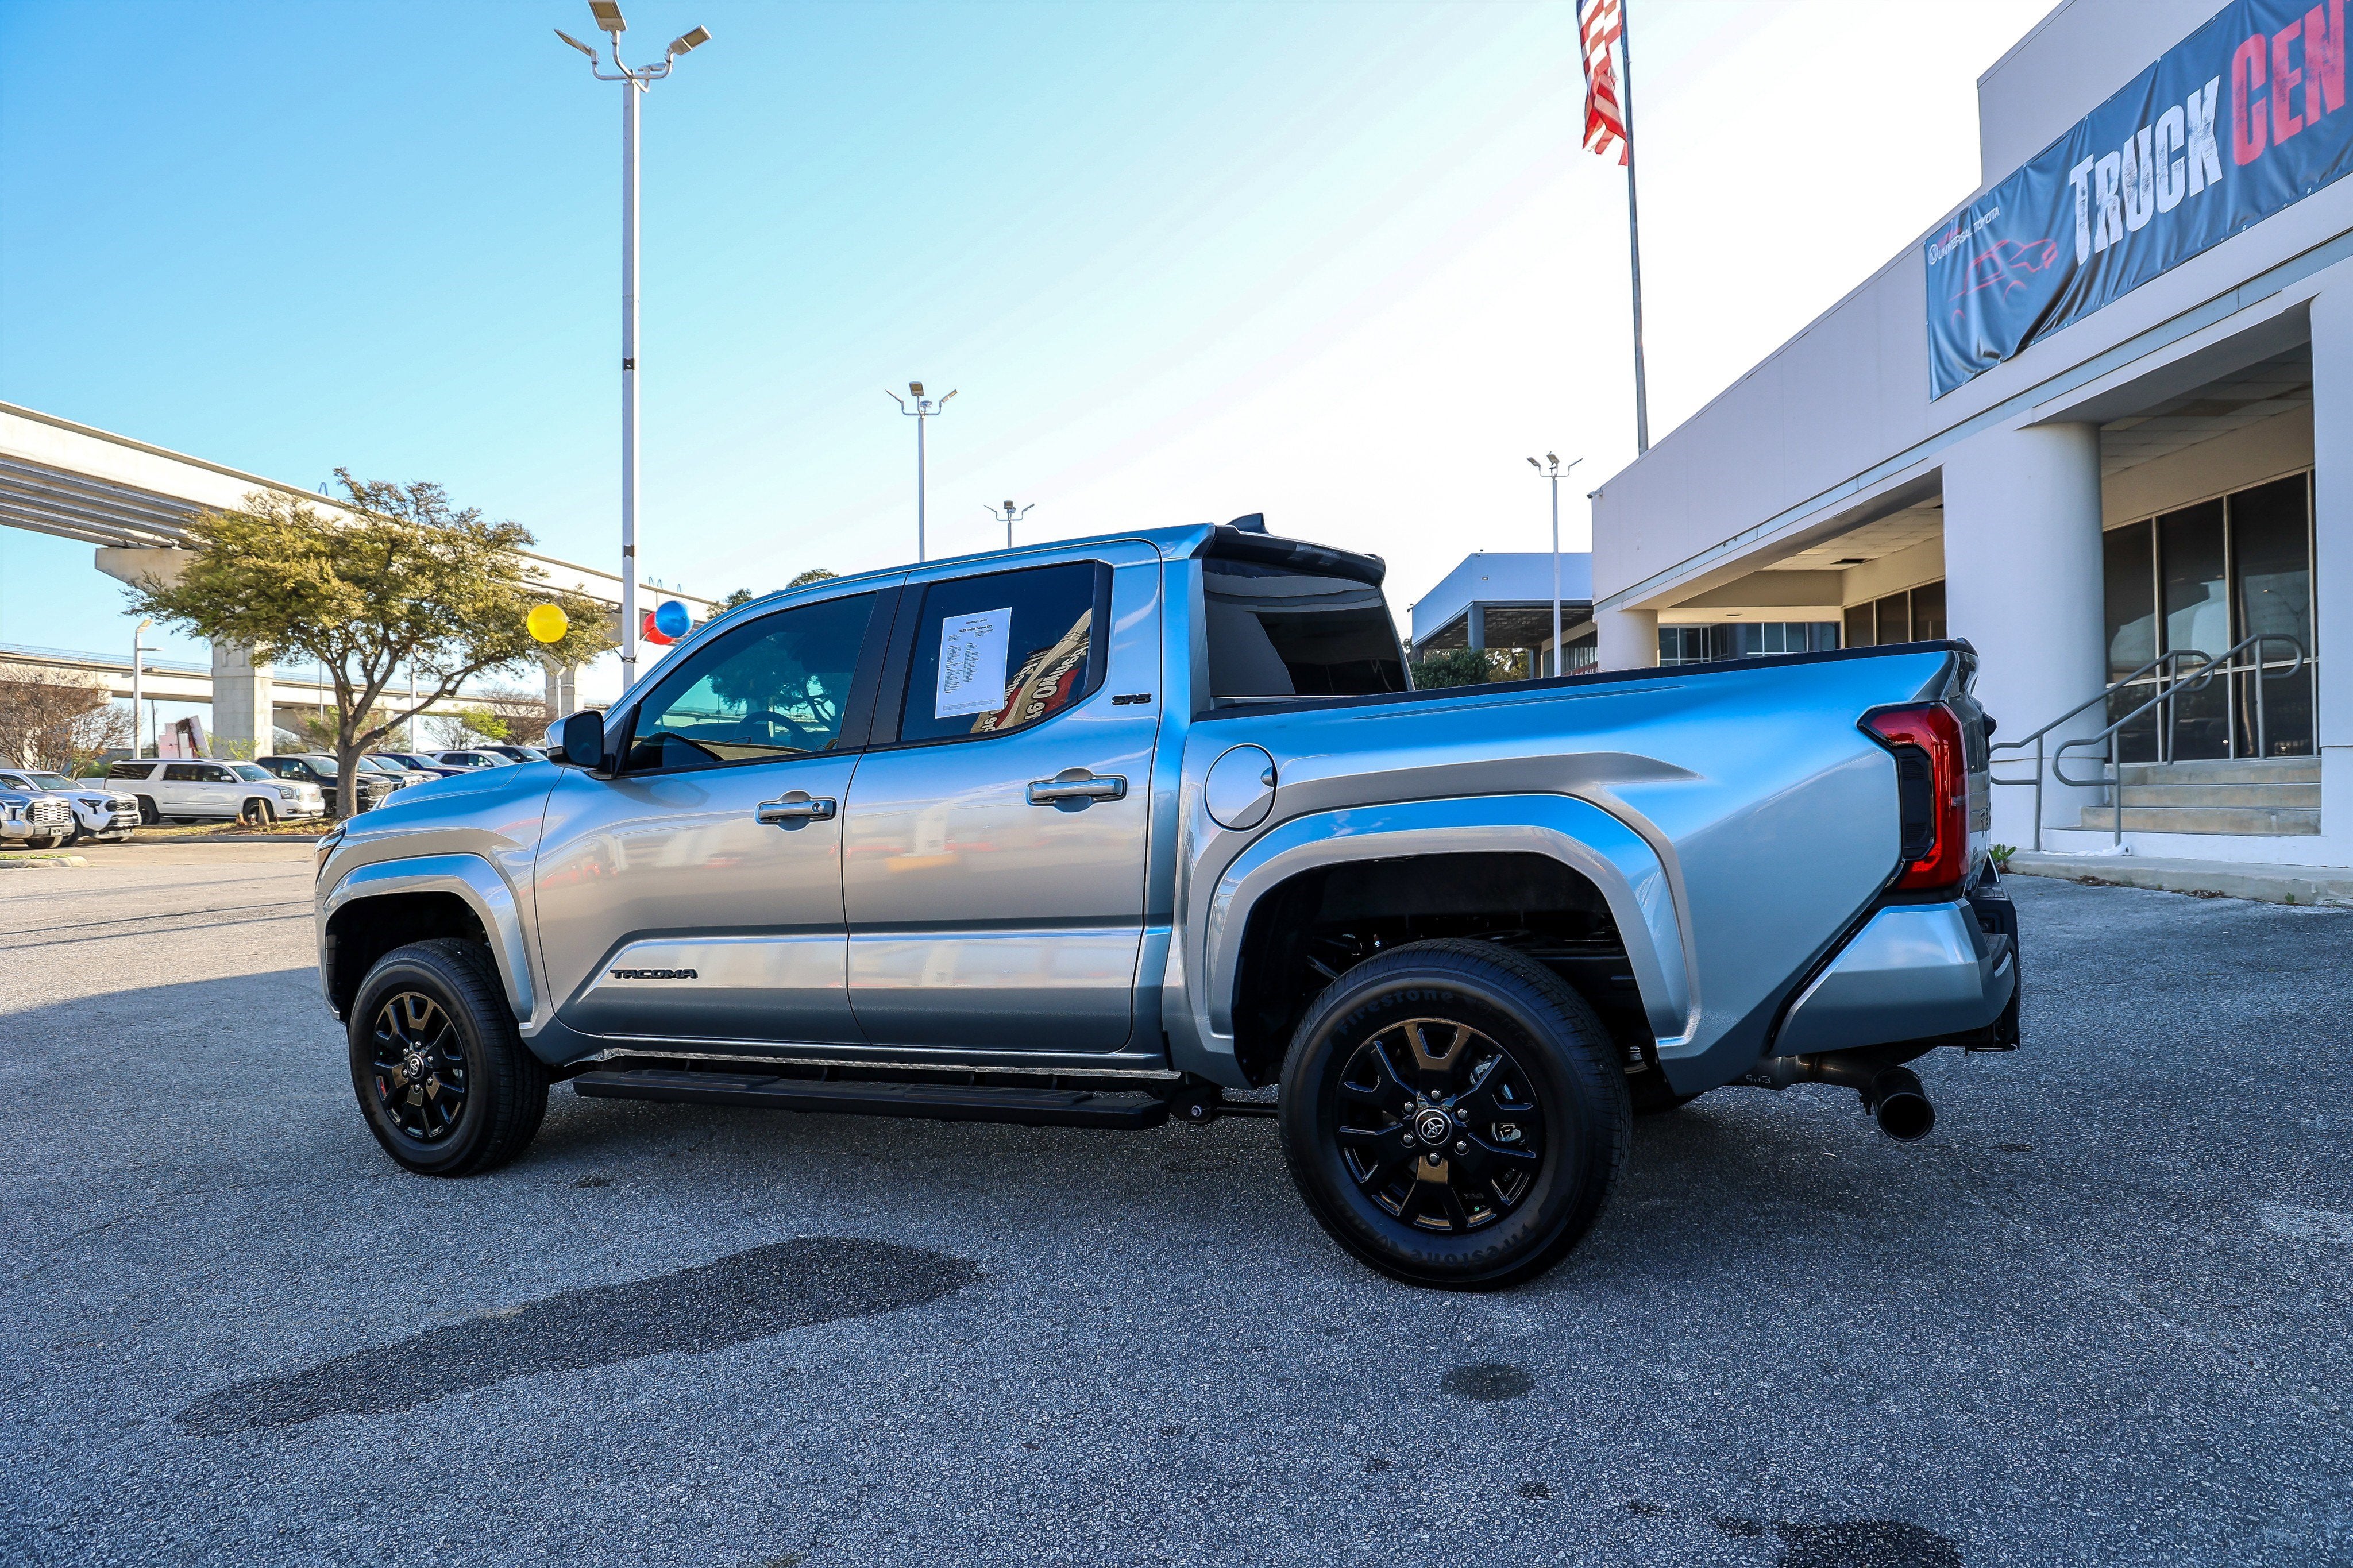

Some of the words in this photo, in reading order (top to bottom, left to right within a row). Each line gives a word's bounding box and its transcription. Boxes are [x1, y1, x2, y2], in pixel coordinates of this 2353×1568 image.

[2069, 75, 2223, 267] TRUCK
[2231, 0, 2348, 166] CEN
[1938, 226, 1973, 260] UNIVERSAL
[1973, 206, 2000, 233] TOYOTA
[1111, 693, 1152, 706] SR5
[610, 968, 699, 979] TACOMA
[1337, 987, 1456, 1036] Firestone
[1409, 1222, 1535, 1268] Firestone
